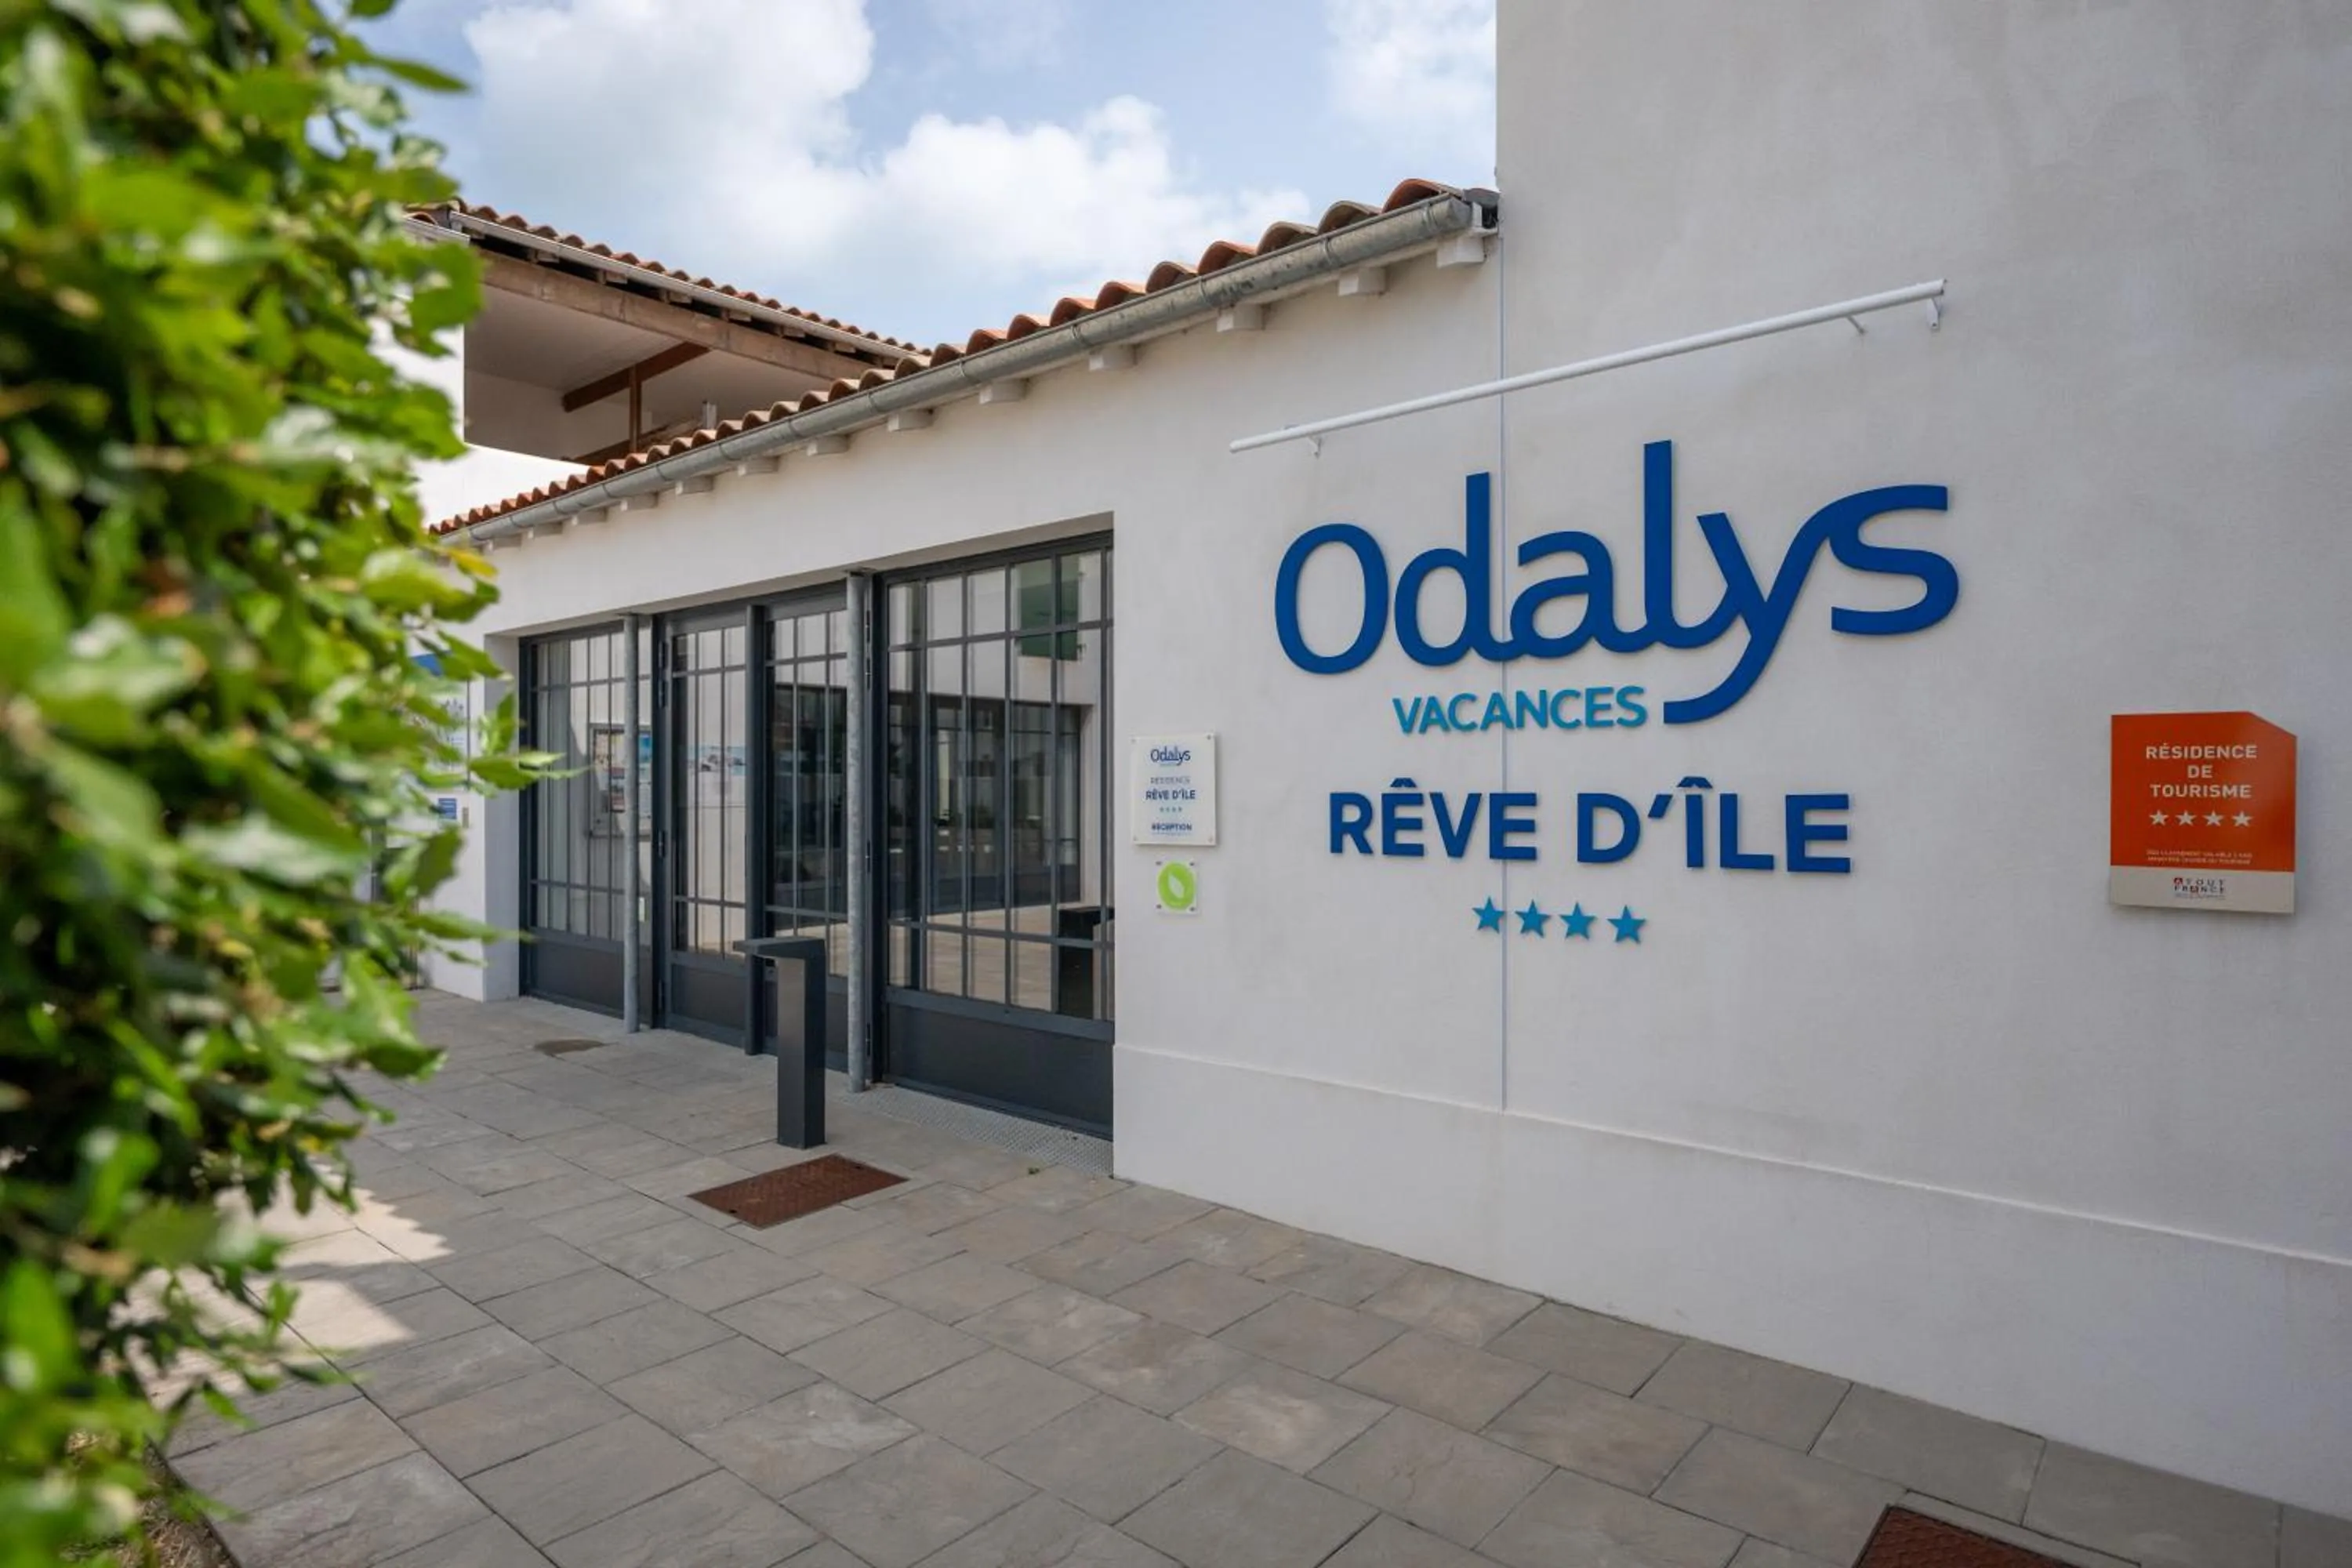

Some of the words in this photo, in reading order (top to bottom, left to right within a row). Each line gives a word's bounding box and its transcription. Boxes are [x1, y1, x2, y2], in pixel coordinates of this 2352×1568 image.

[1274, 440, 1961, 724] Odalys
[1392, 685, 1648, 735] VACANCES
[1150, 746, 1191, 766] Odalys
[2146, 742, 2258, 760] RÉSIDENCE
[2187, 764, 2212, 779] DE
[1145, 788, 1168, 800] RÊVE
[2150, 784, 2252, 798] TOURISME
[1329, 777, 1538, 861] RÊVE
[1576, 776, 1852, 873] D'ÎLE
